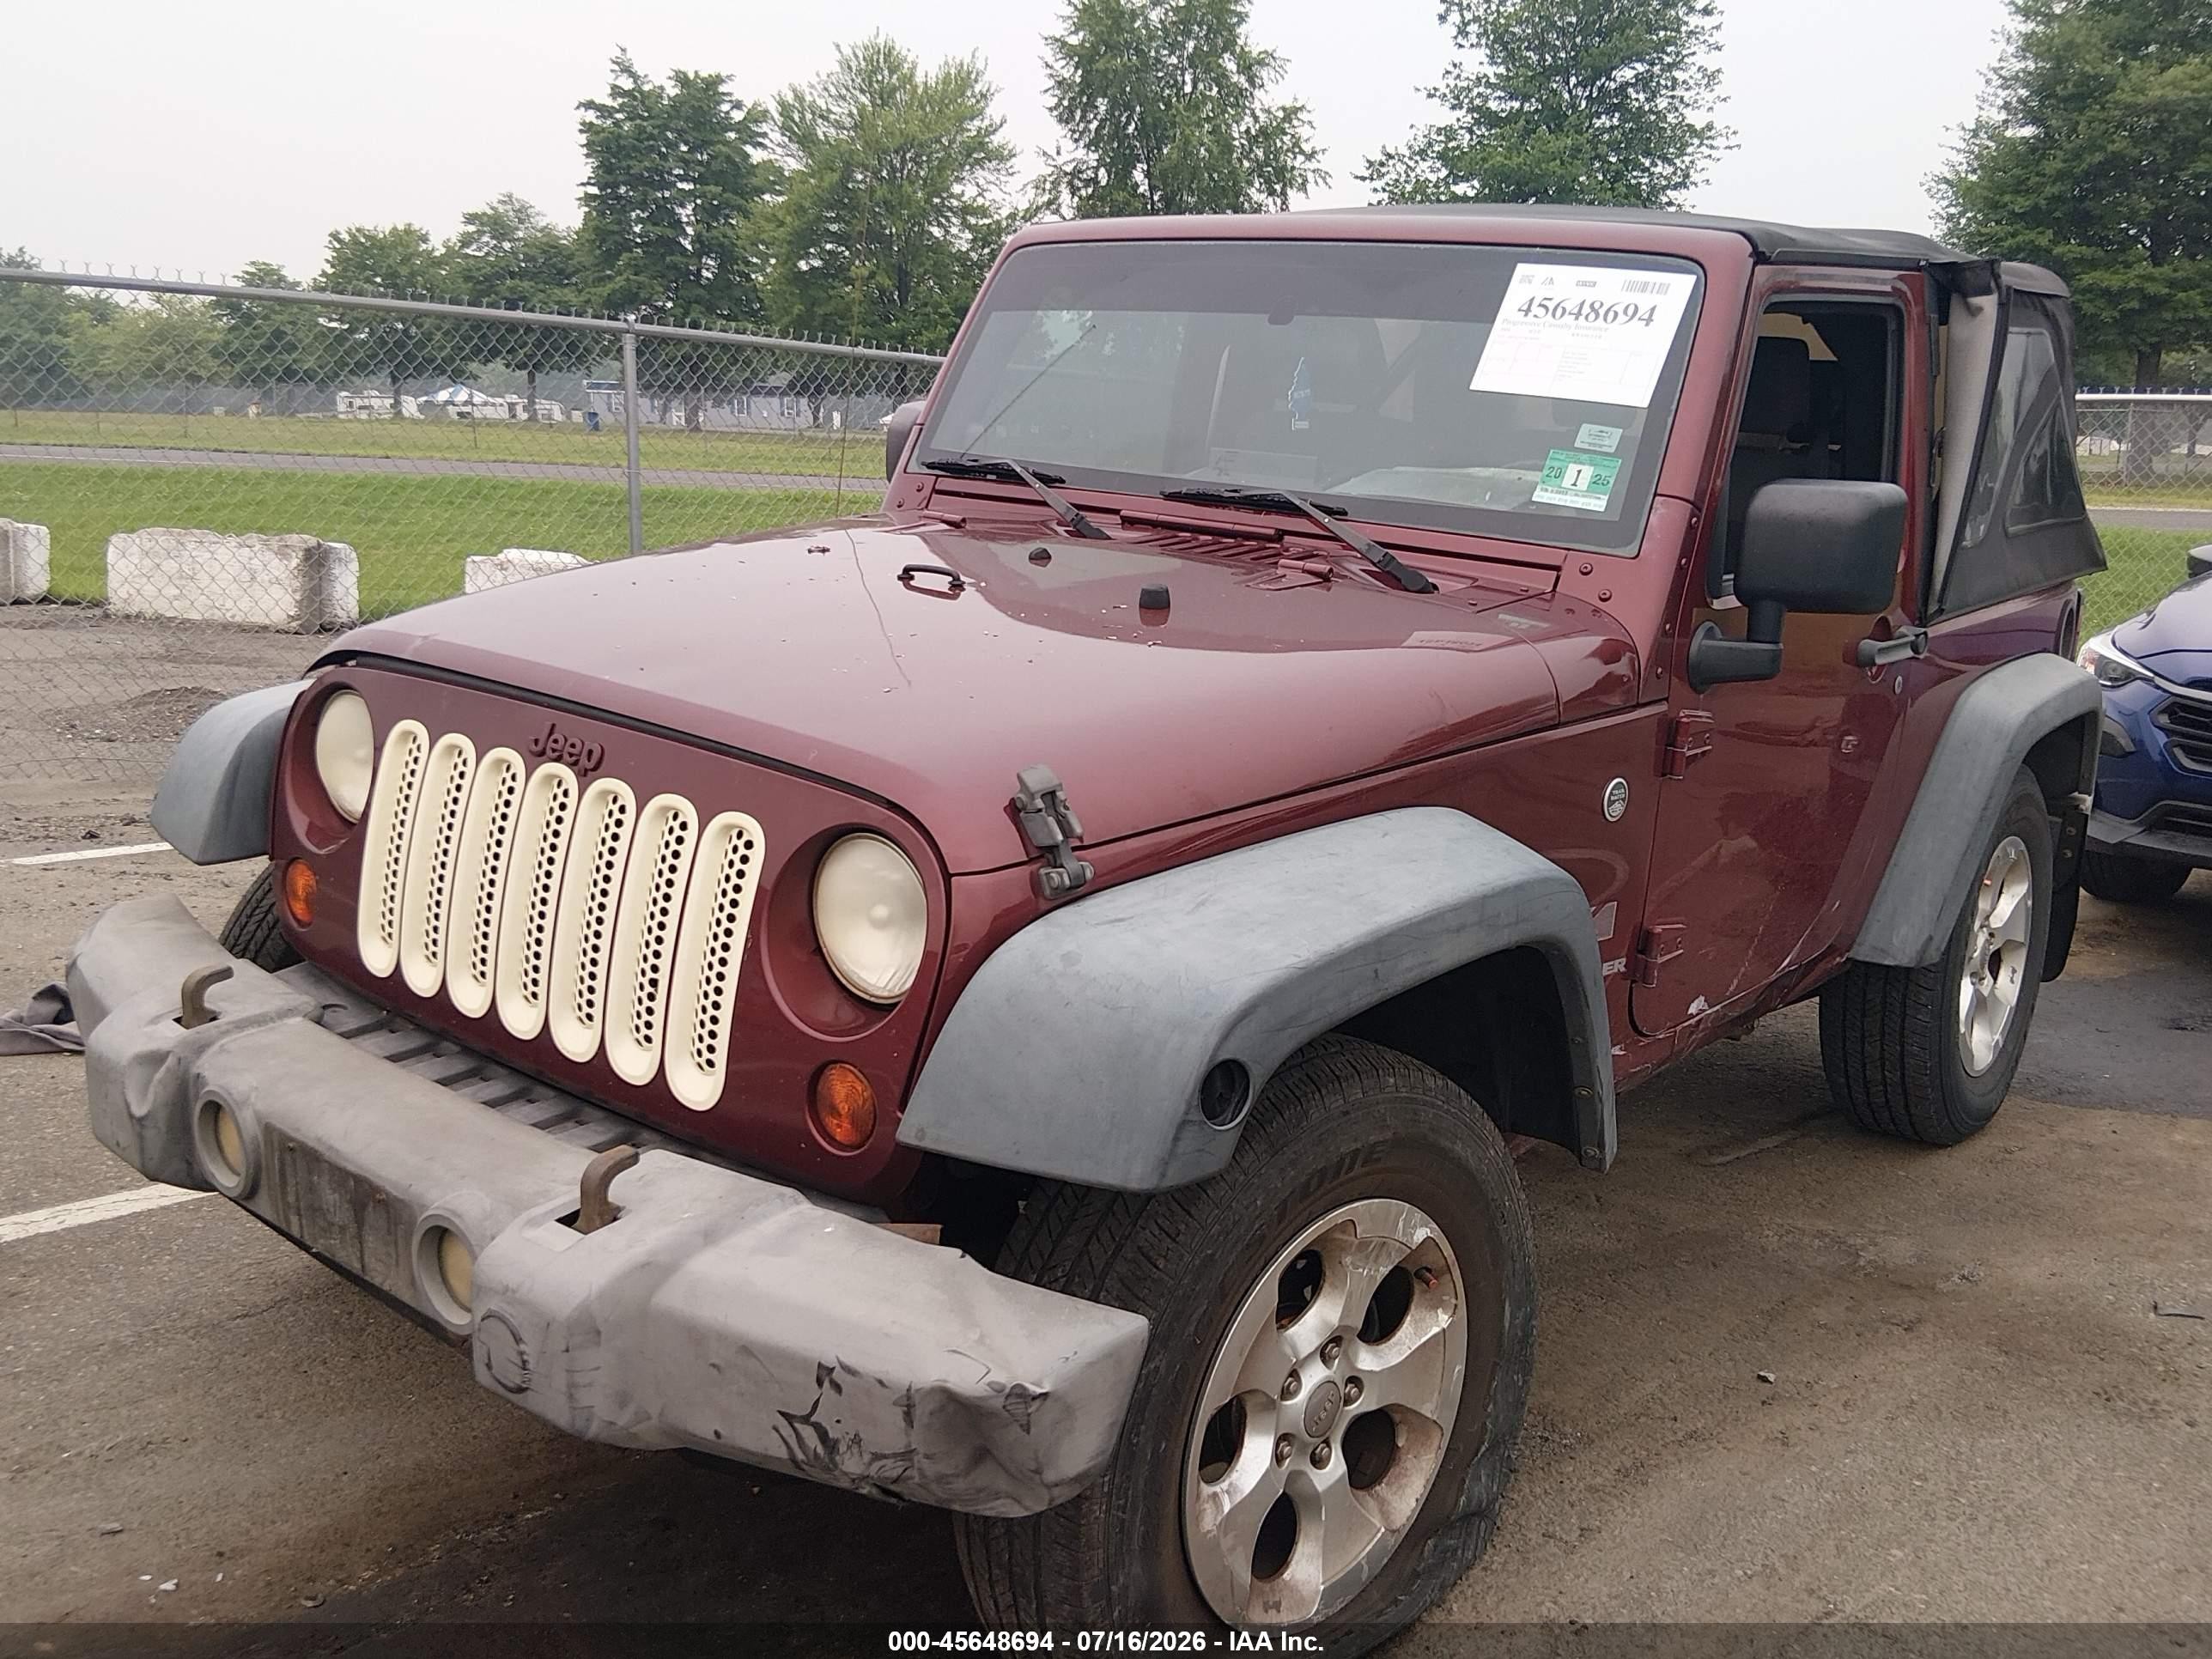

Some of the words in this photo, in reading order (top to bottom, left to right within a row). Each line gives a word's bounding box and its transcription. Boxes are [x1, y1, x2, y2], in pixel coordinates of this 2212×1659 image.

[1517, 295, 1657, 327] 45648694
[1546, 466, 1563, 480] 20
[1571, 469, 1582, 487] 1
[1592, 474, 1611, 487] 25
[529, 722, 605, 777] Jeep
